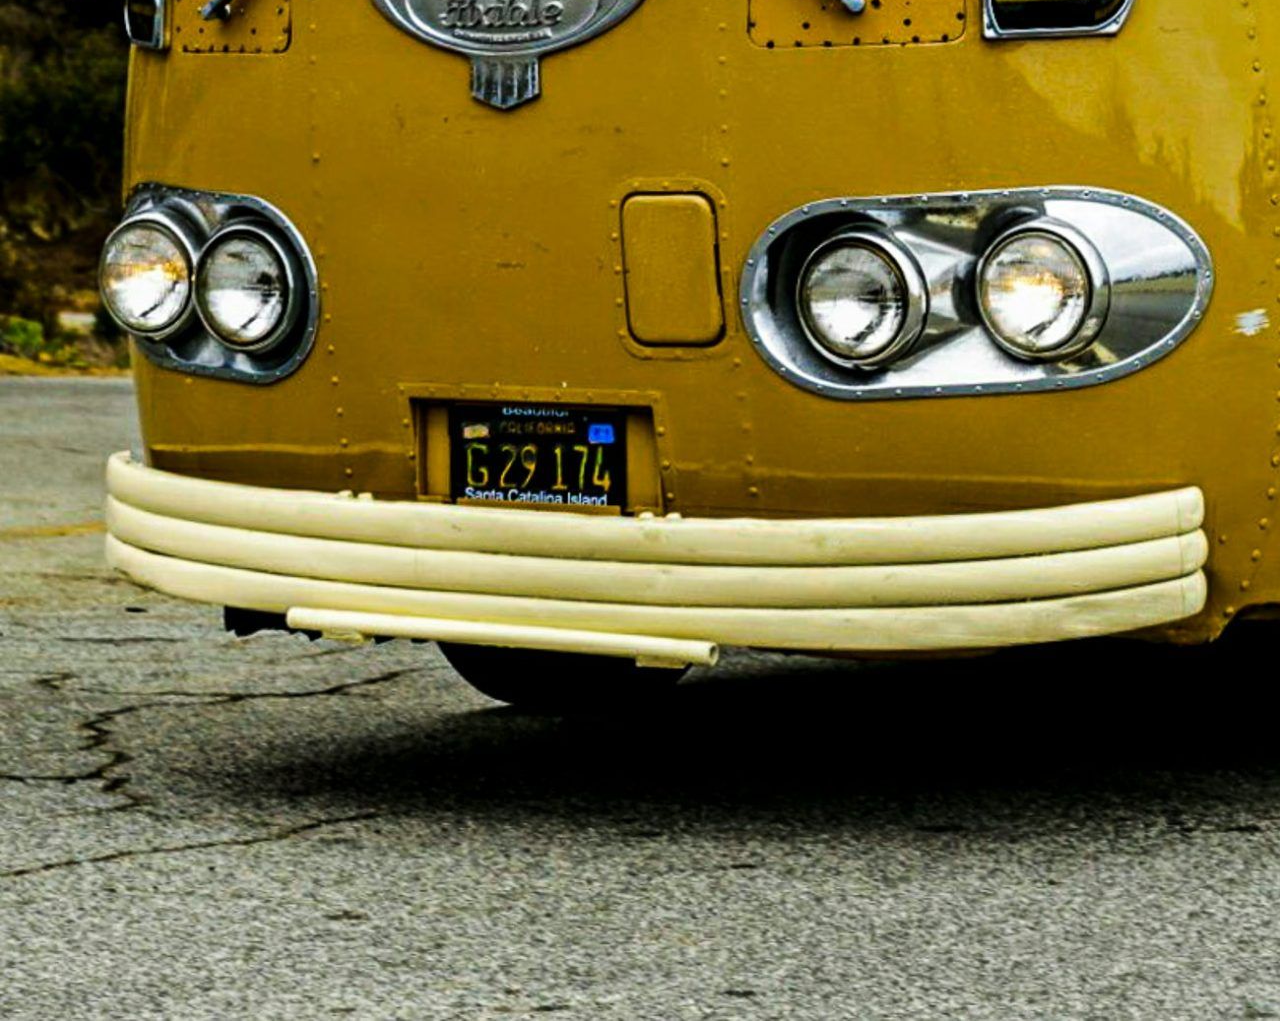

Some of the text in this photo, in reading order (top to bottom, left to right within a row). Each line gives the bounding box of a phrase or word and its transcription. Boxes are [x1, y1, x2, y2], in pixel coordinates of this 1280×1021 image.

[552, 445, 612, 492] 174
[465, 486, 609, 507] Santa Catalina Island
